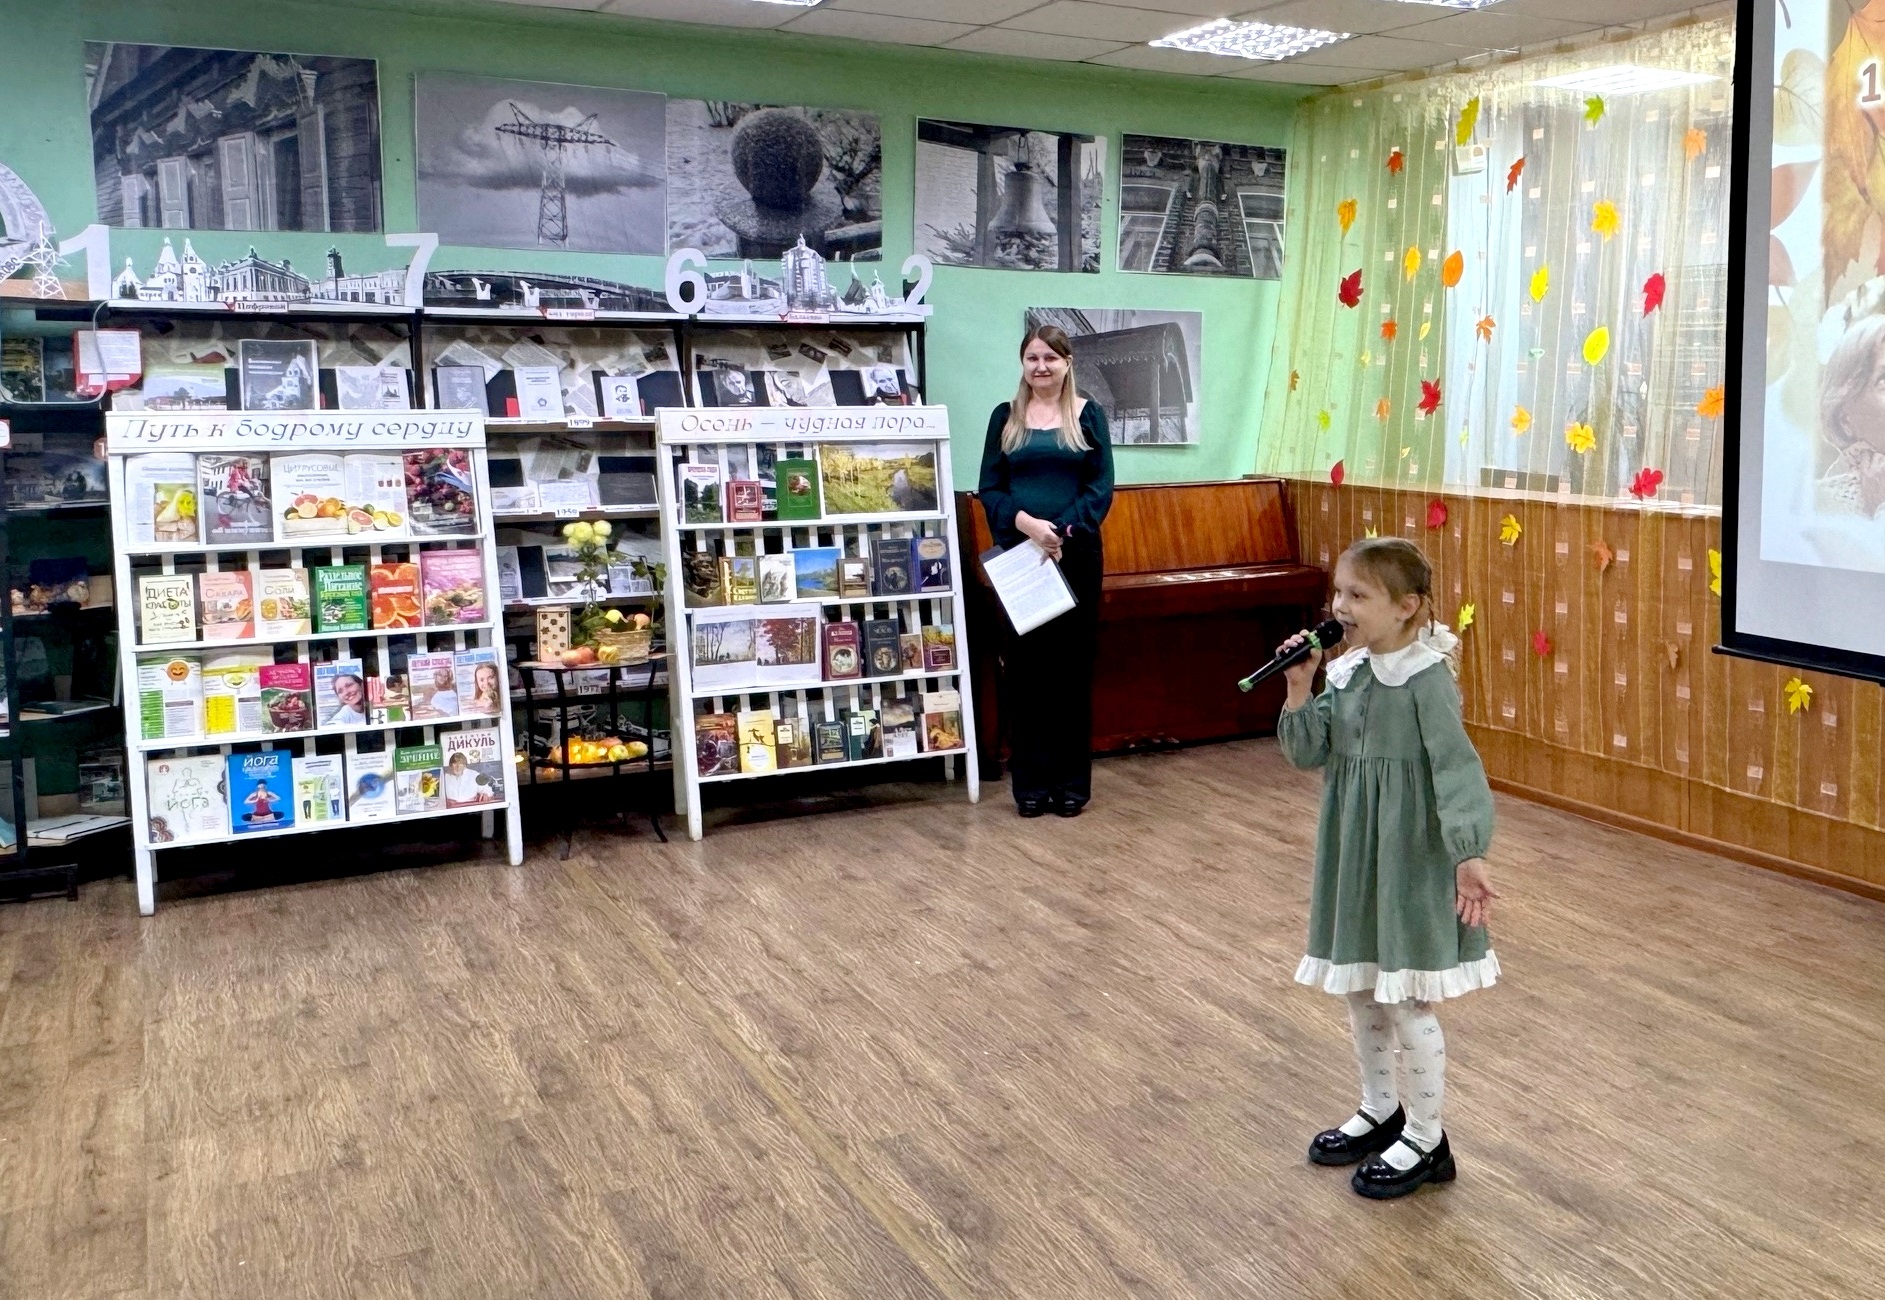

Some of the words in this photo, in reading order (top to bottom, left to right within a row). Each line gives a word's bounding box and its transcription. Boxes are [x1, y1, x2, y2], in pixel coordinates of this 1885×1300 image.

[385, 233, 438, 308] 7
[665, 247, 707, 313] 6
[901, 254, 933, 315] 2
[122, 419, 199, 442] Путь
[206, 424, 228, 437] к
[236, 419, 364, 441] бодрому
[372, 420, 473, 440] сердцу
[681, 415, 753, 432] Осень
[785, 415, 866, 434] чудная
[448, 737, 496, 752] ДИКУЛЬ
